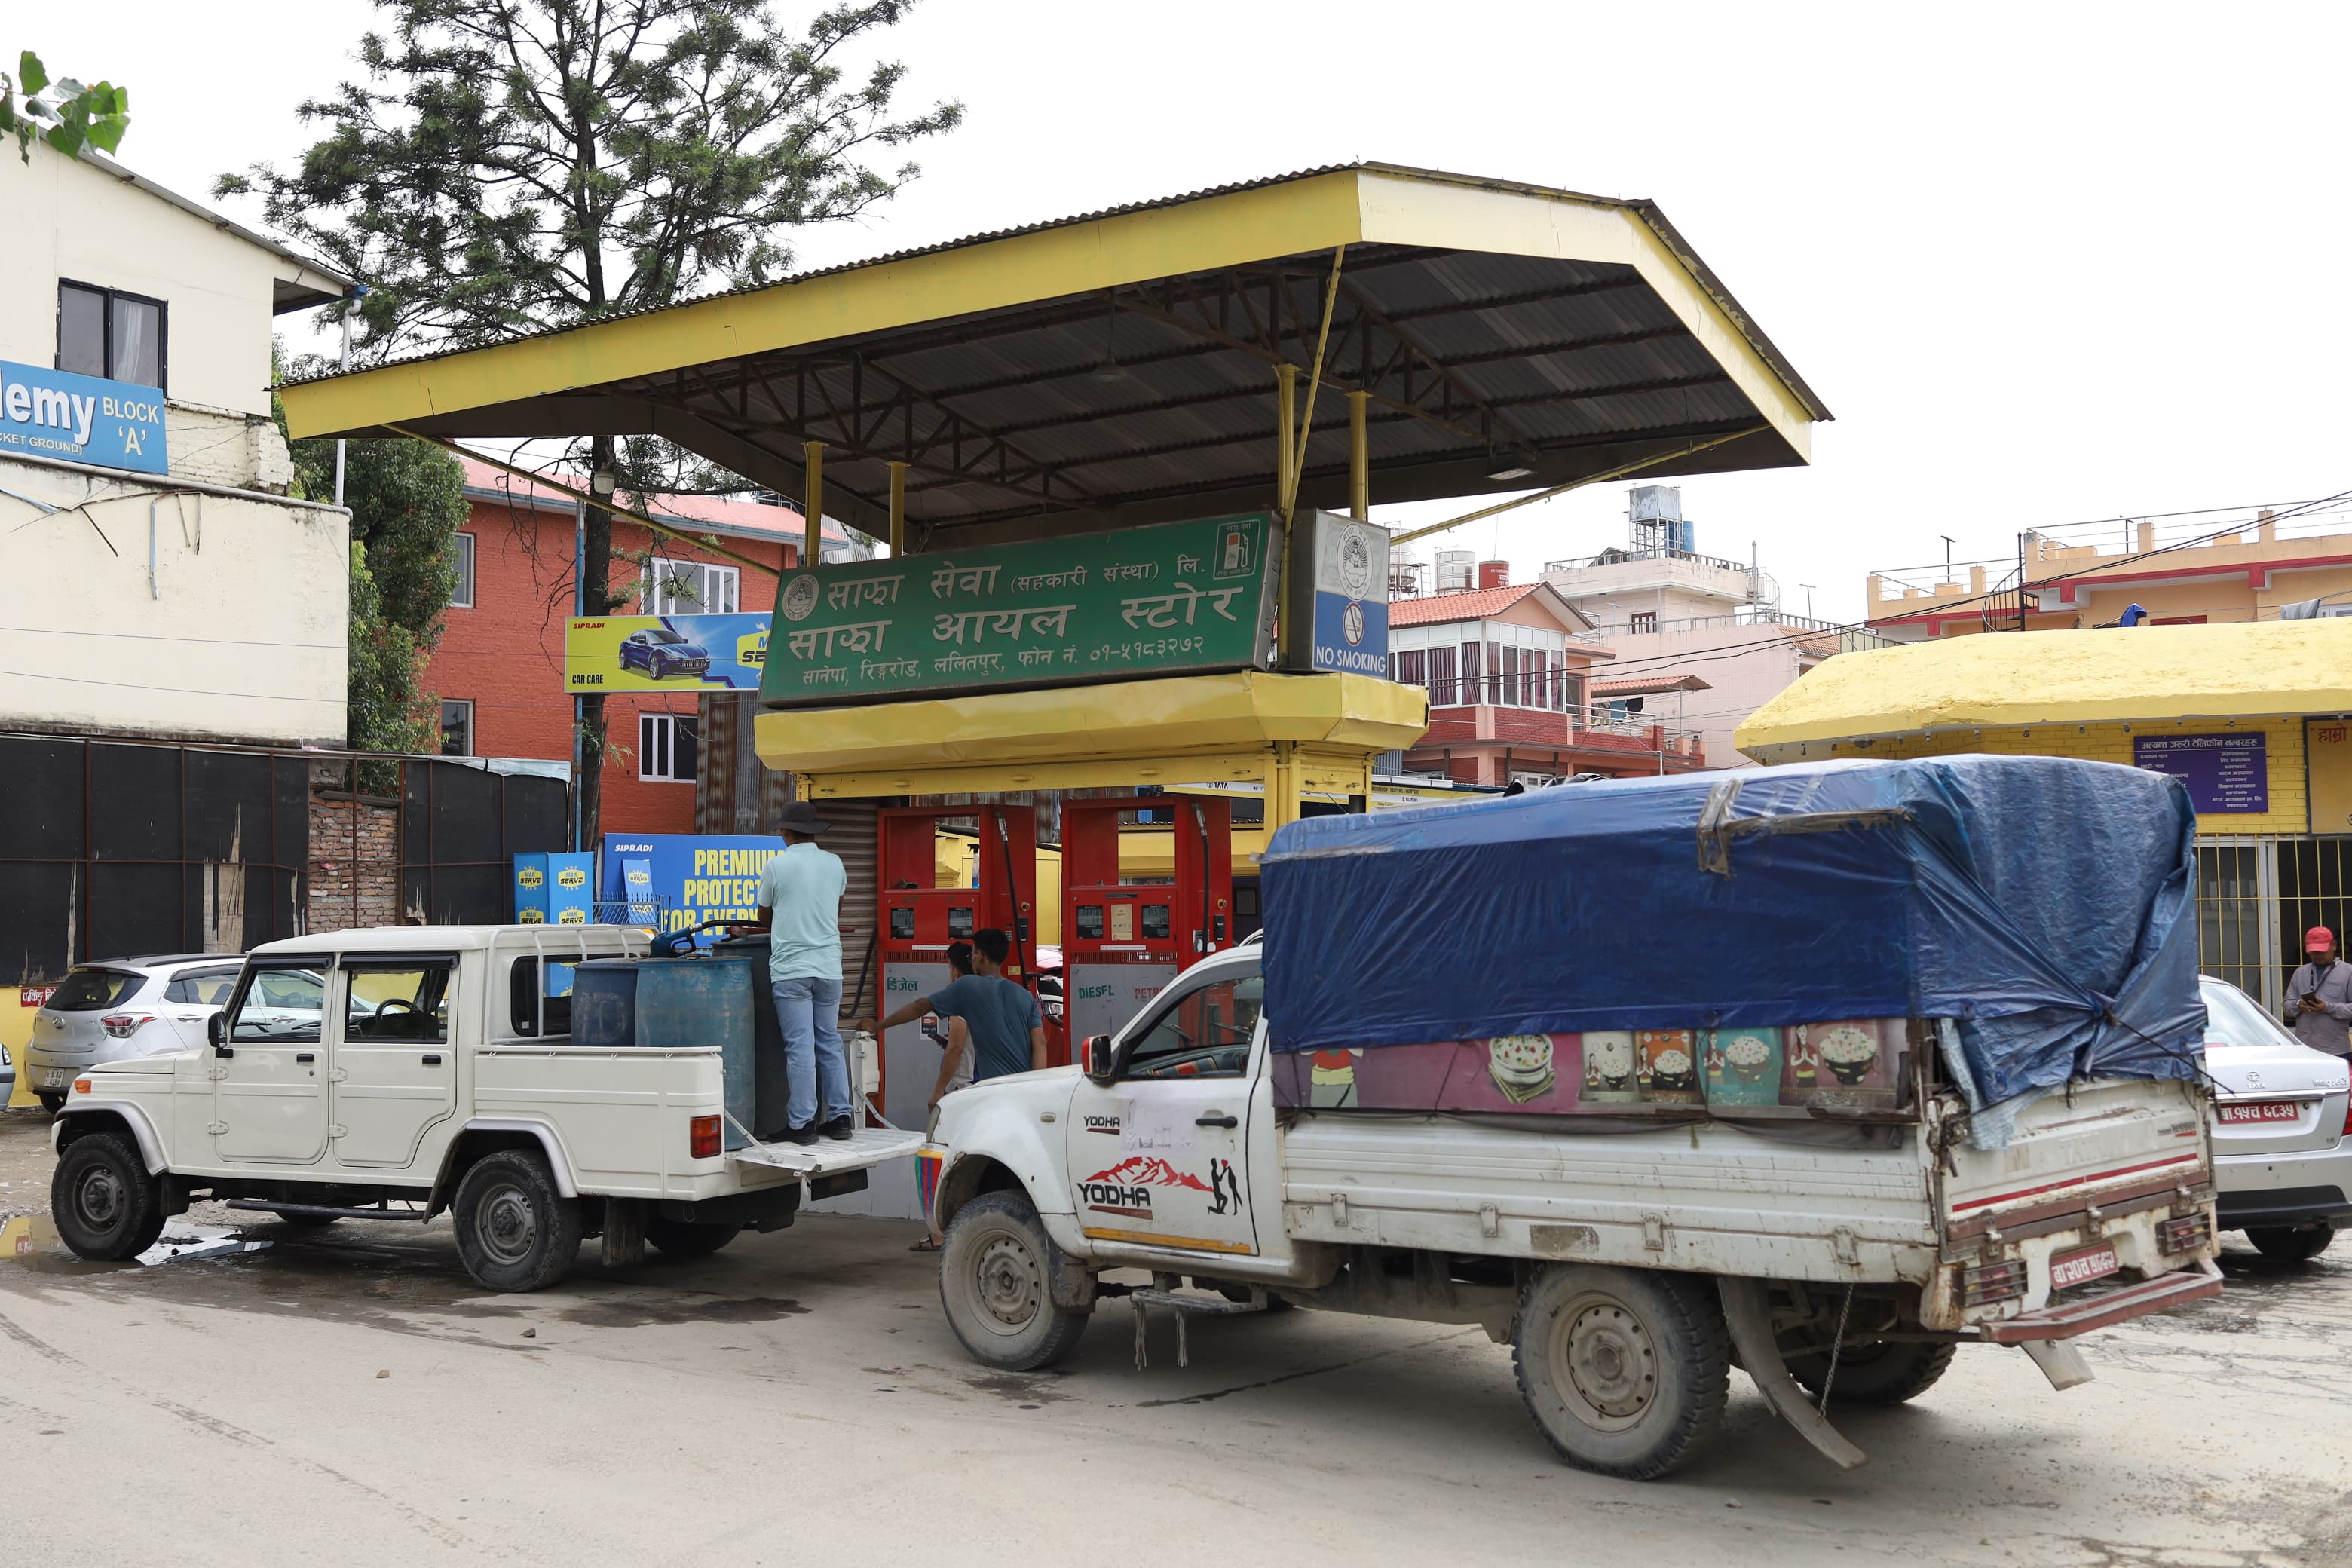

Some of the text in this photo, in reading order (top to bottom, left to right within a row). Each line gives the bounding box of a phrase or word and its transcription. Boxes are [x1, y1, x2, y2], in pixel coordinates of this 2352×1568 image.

[0, 368, 96, 446] emy
[103, 397, 159, 424] BLOCK
[29, 436, 83, 456] GROUND)
[827, 574, 905, 611] साझा
[930, 561, 1001, 599] सेवा
[1011, 565, 1088, 593] (सहकारी
[1104, 561, 1159, 583] संस्था)
[1177, 554, 1205, 575] लि.
[789, 582, 1244, 660] साझा आयल स्टोर
[803, 665, 849, 686] सानेपा,
[935, 651, 1004, 676] ललितपुर,
[1018, 646, 1054, 666] फोन
[1316, 645, 1386, 673] NO SMOKING
[572, 674, 603, 684] CAR CARE
[887, 977, 918, 991] डिजेल
[1084, 1116, 1120, 1128] YODHA
[1076, 1183, 1151, 1208] YODHA
